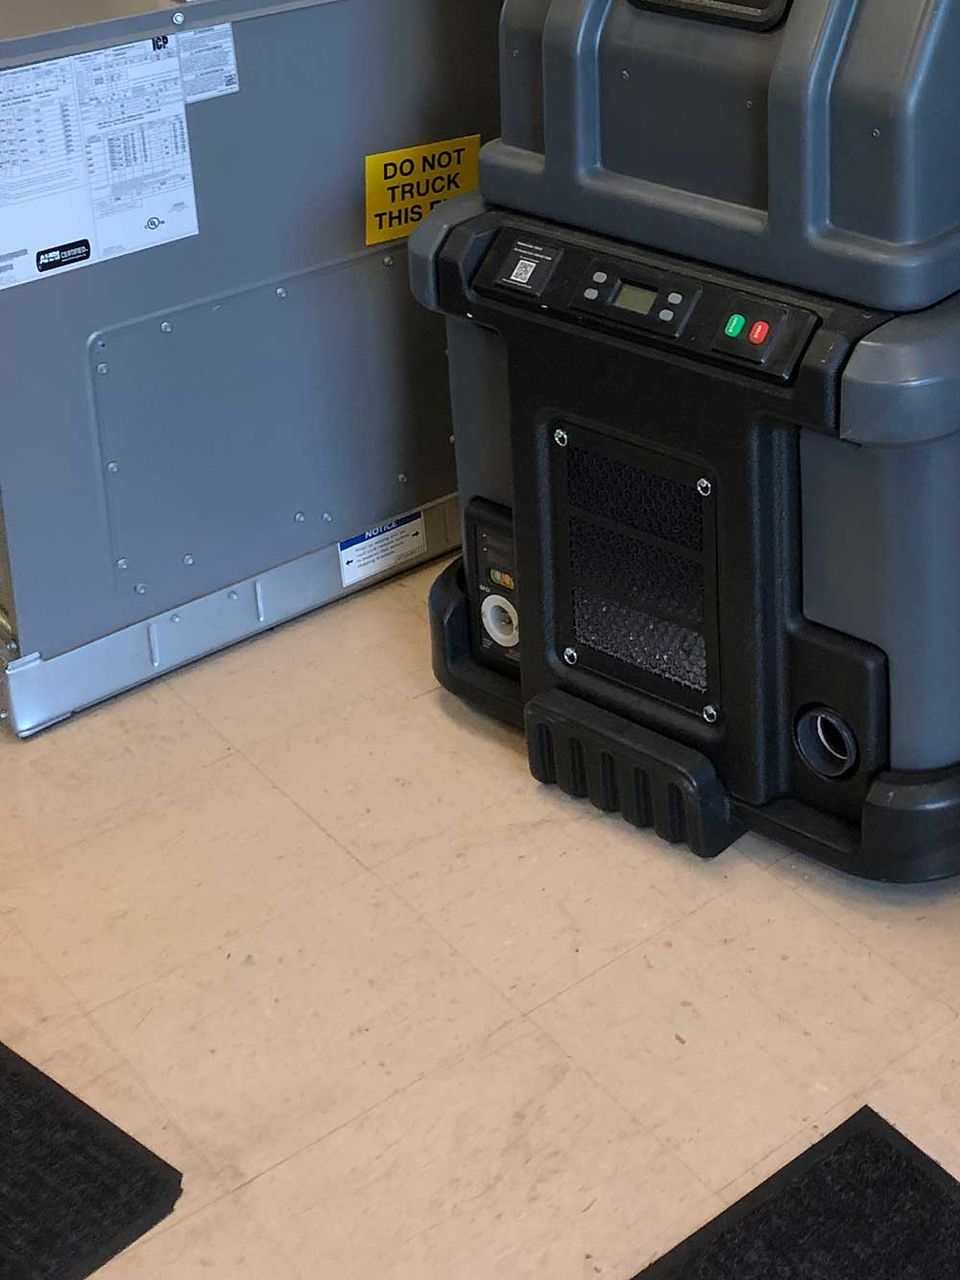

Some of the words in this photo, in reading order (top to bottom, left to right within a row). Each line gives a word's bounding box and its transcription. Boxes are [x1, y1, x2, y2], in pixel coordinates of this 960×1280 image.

[151, 35, 168, 51] ICP
[383, 158, 414, 180] DO
[422, 148, 466, 173] NOT
[387, 172, 460, 203] TRUCK
[374, 204, 423, 230] THIS
[365, 520, 398, 539] NOTICE
